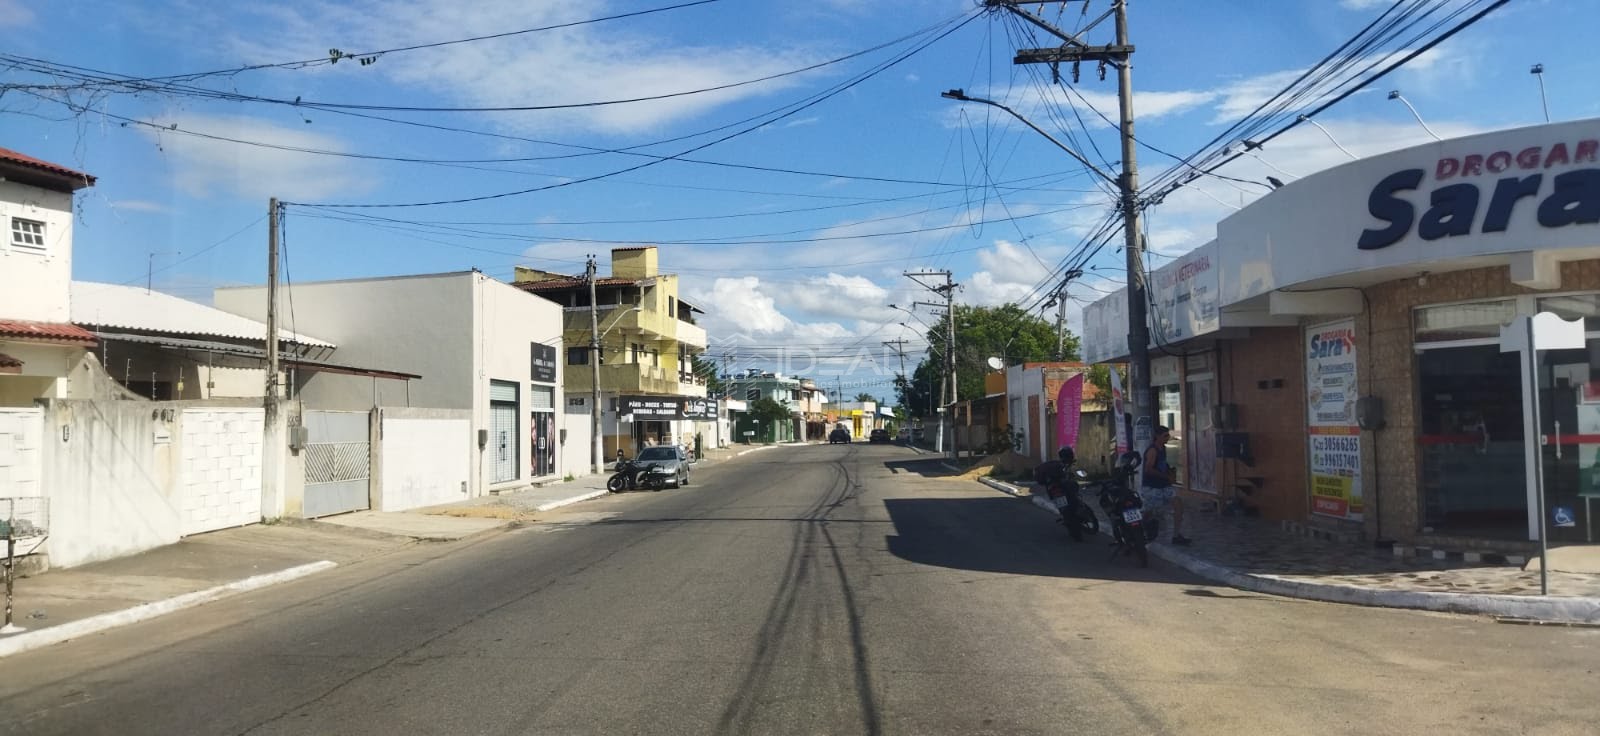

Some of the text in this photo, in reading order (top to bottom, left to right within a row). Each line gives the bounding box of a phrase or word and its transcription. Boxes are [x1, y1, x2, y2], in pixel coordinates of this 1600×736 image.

[1435, 139, 1600, 180] DROGAR
[1357, 168, 1600, 250] Sara
[1309, 334, 1344, 359] Sara
